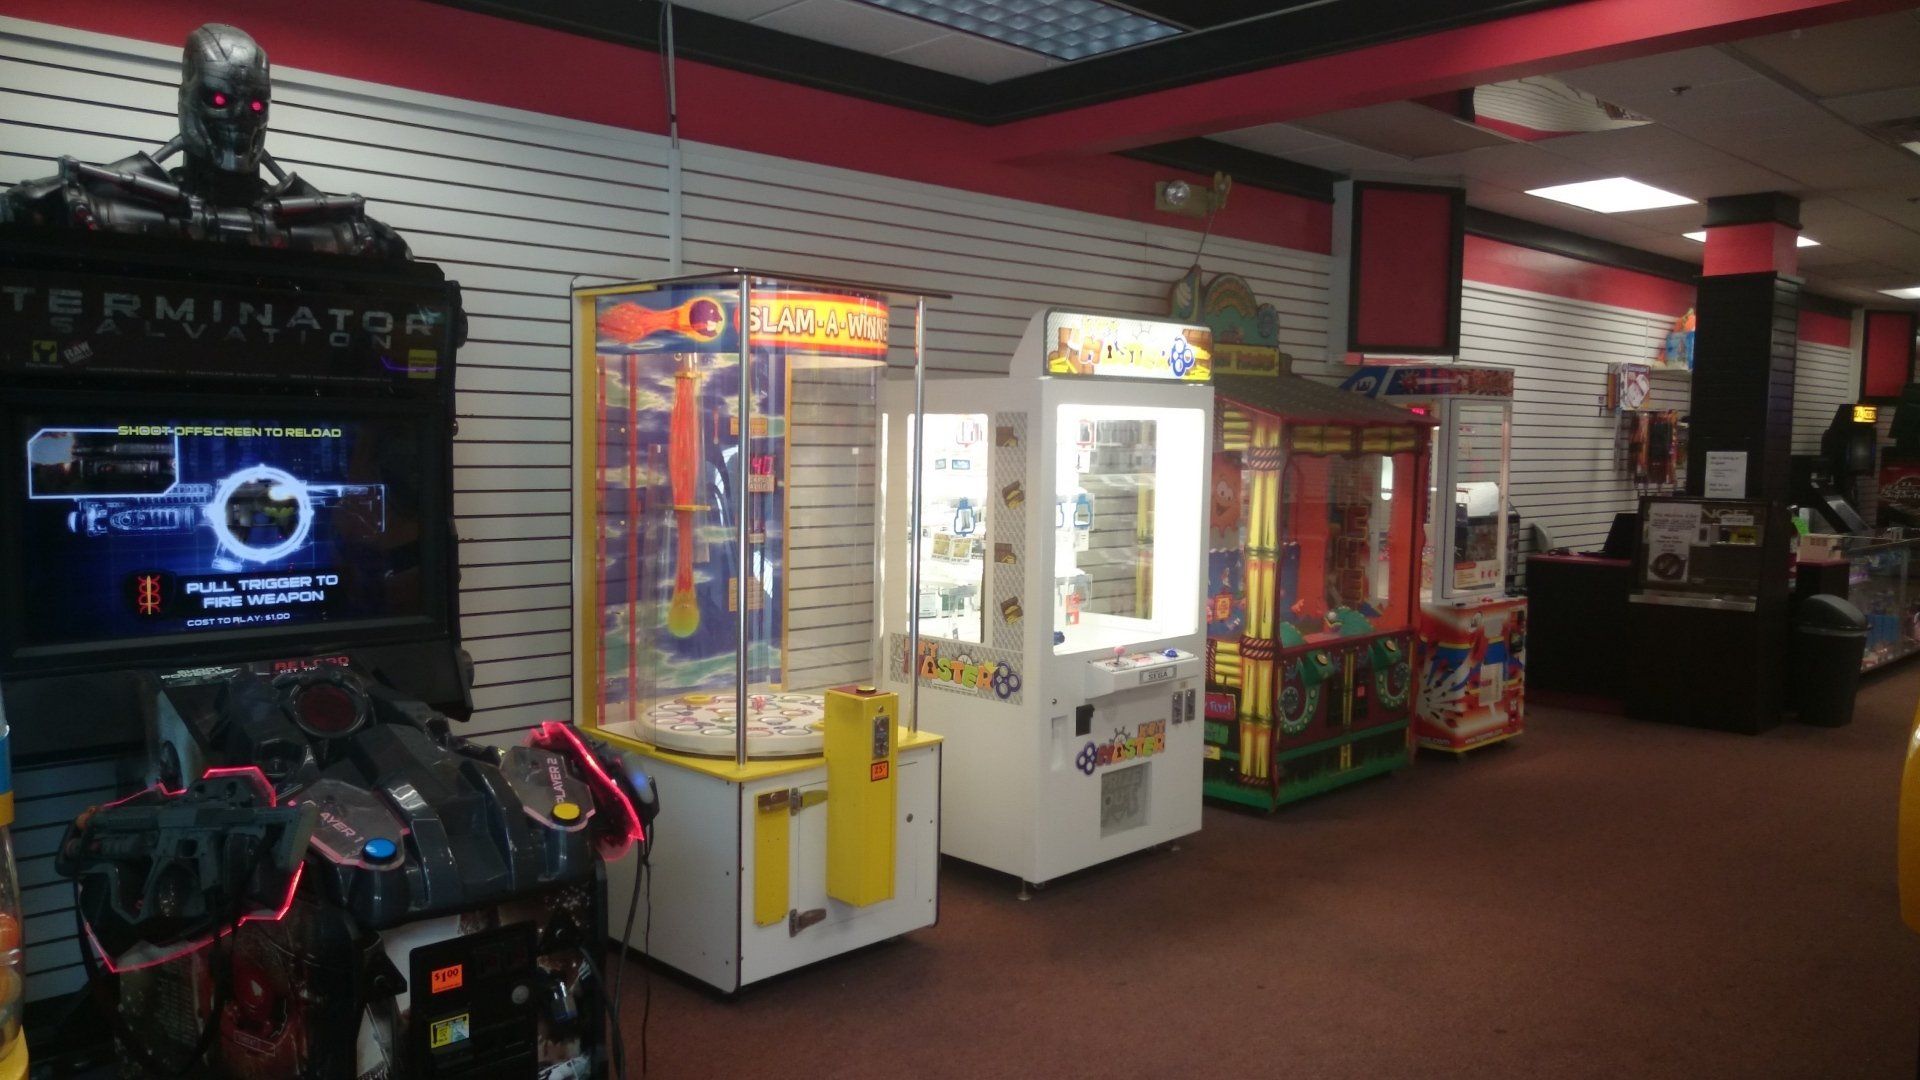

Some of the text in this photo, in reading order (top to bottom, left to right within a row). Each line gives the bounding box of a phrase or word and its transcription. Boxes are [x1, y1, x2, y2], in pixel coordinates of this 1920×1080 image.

[3, 286, 436, 336] TERMINATOR
[49, 316, 392, 349] SALVATION
[749, 304, 888, 343] SLAM-A-WINNE
[118, 426, 342, 438] SHOOT OFFSCREEN TO RELOAD
[186, 575, 339, 594] PULL TRIGGER TO
[203, 590, 325, 609] FIRE WEAPON
[187, 618, 215, 627] COST
[217, 617, 231, 625] TO
[264, 612, 291, 621] $1.00
[1148, 671, 1168, 681] SEGA
[1096, 733, 1166, 766] MASTER
[320, 812, 356, 837] AYER
